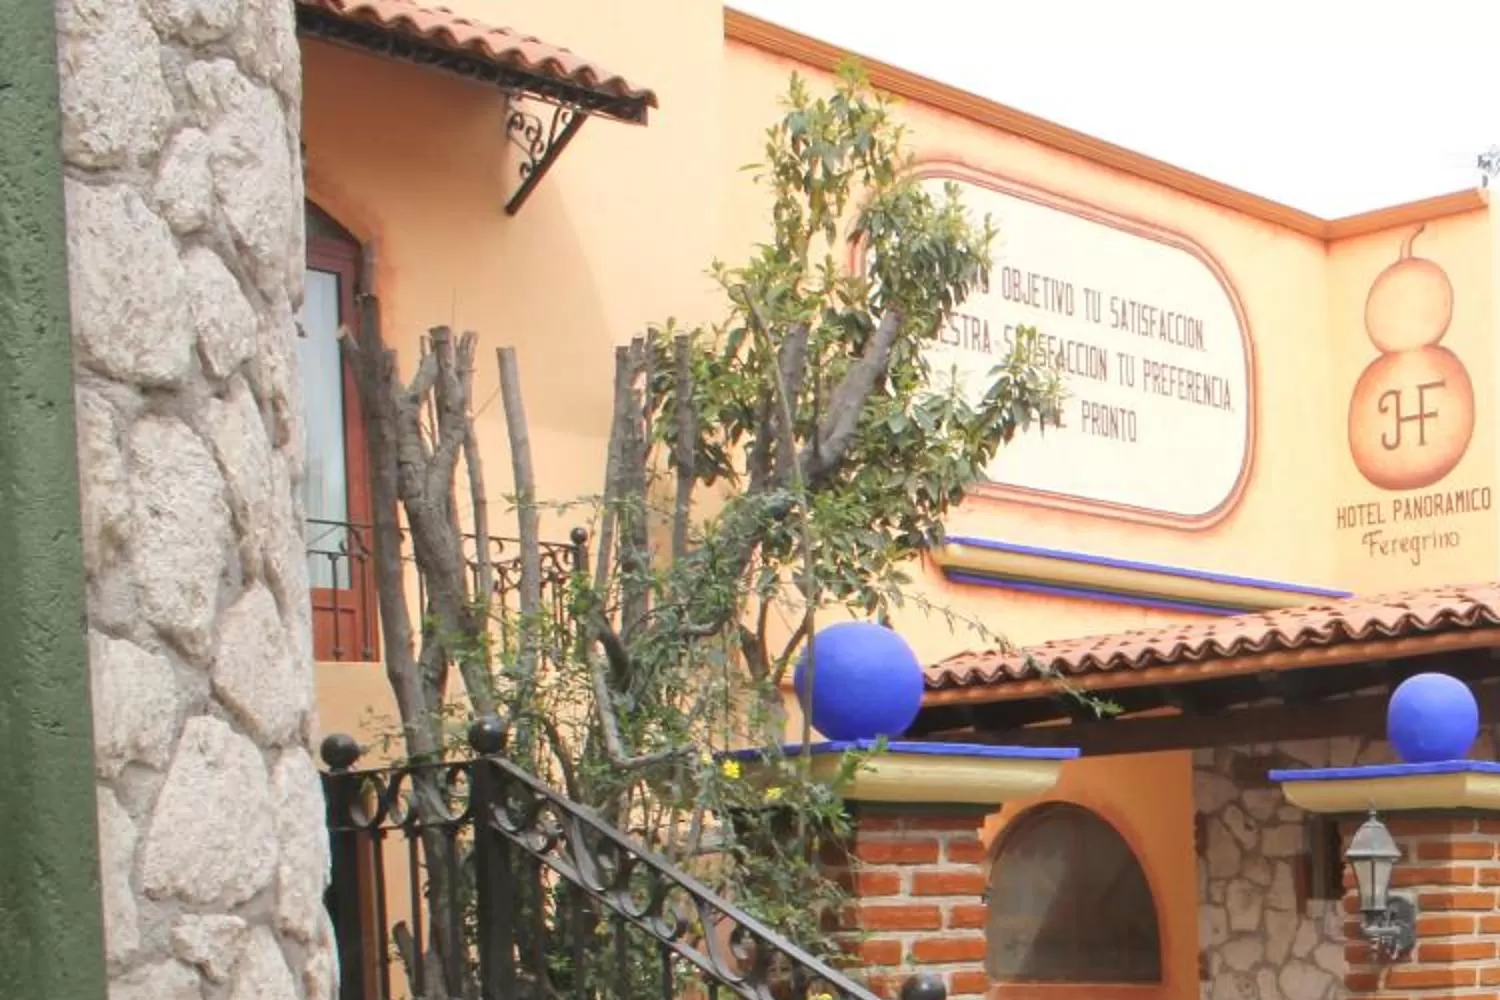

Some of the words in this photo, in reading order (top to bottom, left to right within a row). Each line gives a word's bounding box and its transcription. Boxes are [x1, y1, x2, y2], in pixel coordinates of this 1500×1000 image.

[1001, 265, 1075, 317] OBJETIVO
[1083, 287, 1102, 324] TU
[1116, 350, 1135, 388] TU
[1081, 399, 1137, 443] PRONTO
[1336, 501, 1386, 530] HOTEL
[1392, 486, 1492, 522] PANORAMICO
[1362, 529, 1461, 567] Feregrino
